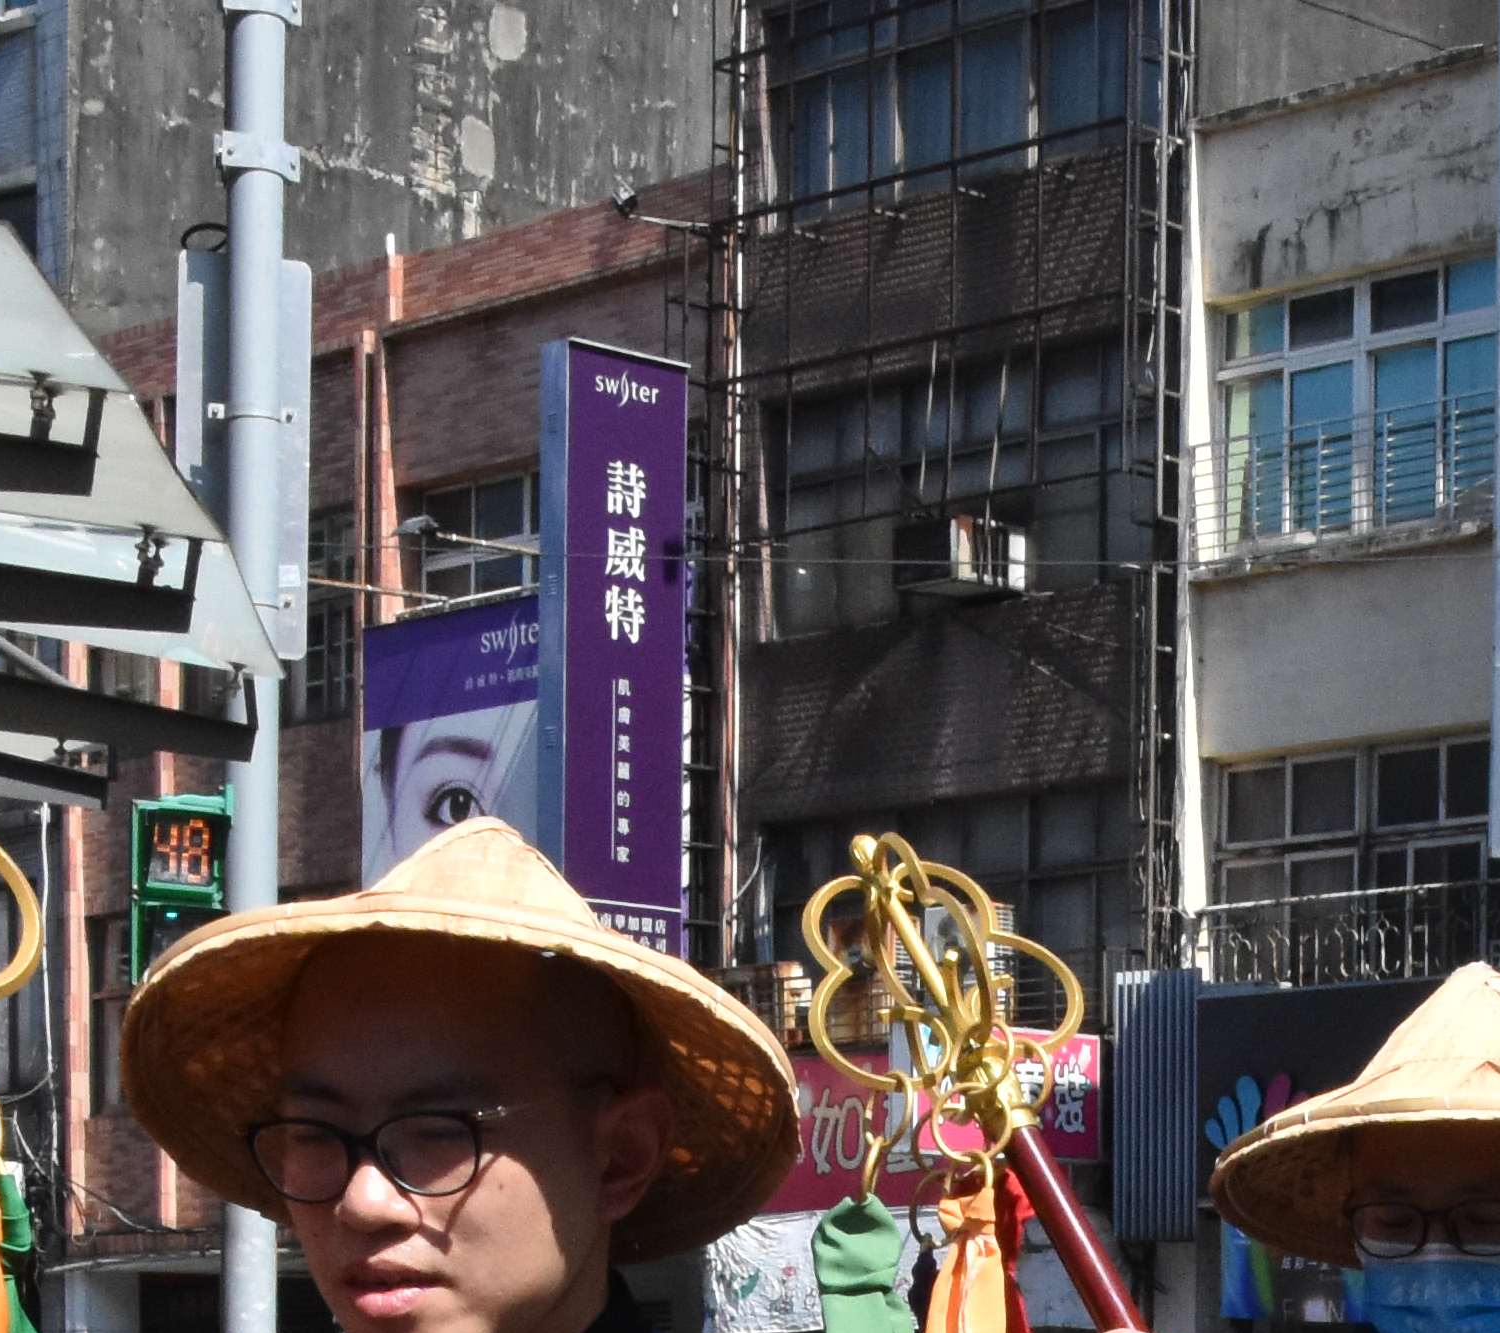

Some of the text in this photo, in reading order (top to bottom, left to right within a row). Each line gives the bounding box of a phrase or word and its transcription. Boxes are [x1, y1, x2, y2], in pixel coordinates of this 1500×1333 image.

[605, 460, 647, 644] 詩威特
[481, 607, 538, 664] swite
[153, 819, 212, 883] 48
